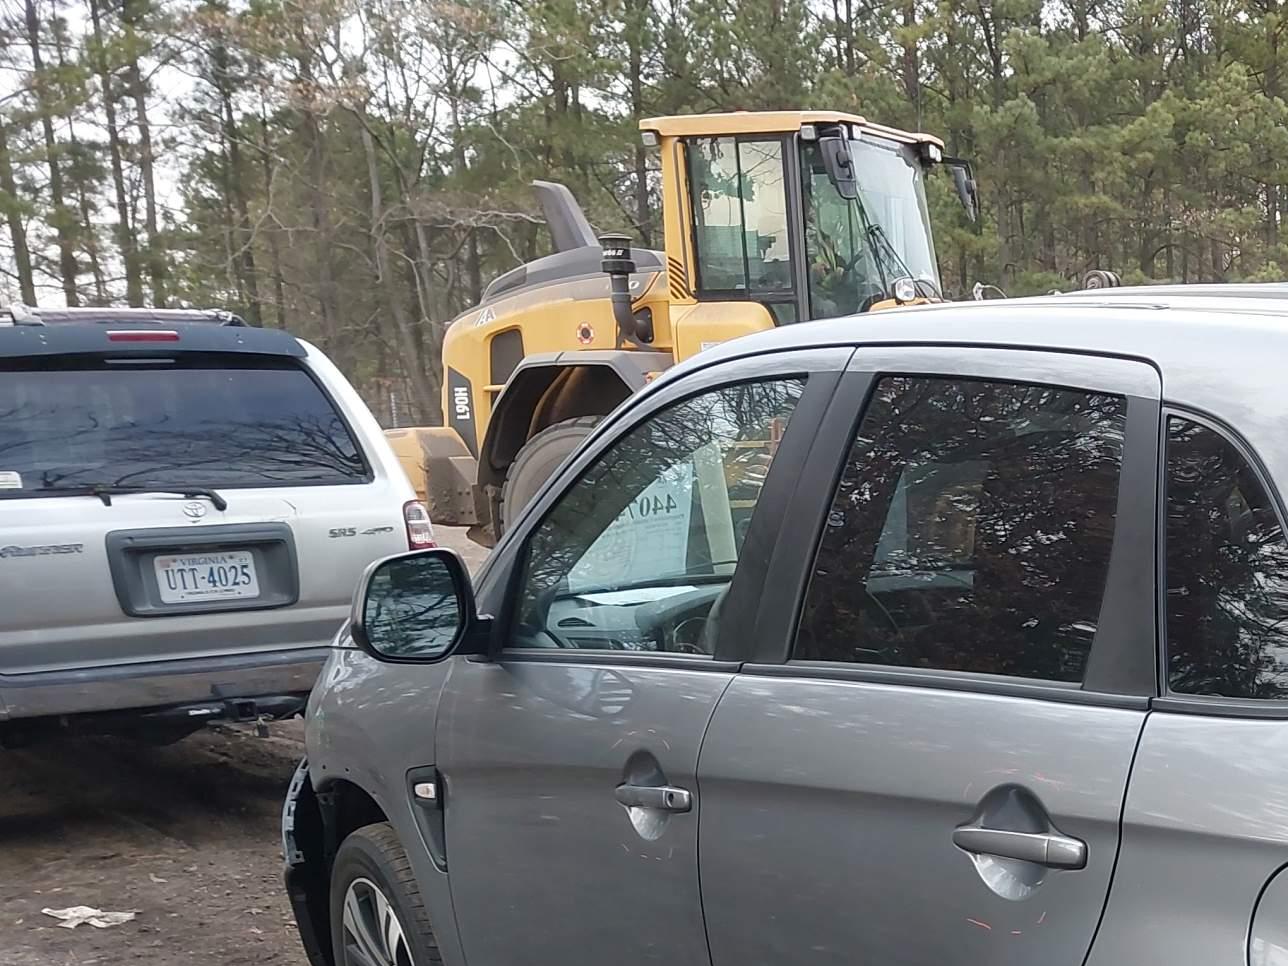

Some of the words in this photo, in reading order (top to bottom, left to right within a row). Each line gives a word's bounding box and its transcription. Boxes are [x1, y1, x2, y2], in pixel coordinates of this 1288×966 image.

[454, 387, 470, 420] L90H
[328, 527, 357, 538] SR5
[180, 556, 228, 567] VIRGINIA
[165, 565, 251, 590] UTT-4025
